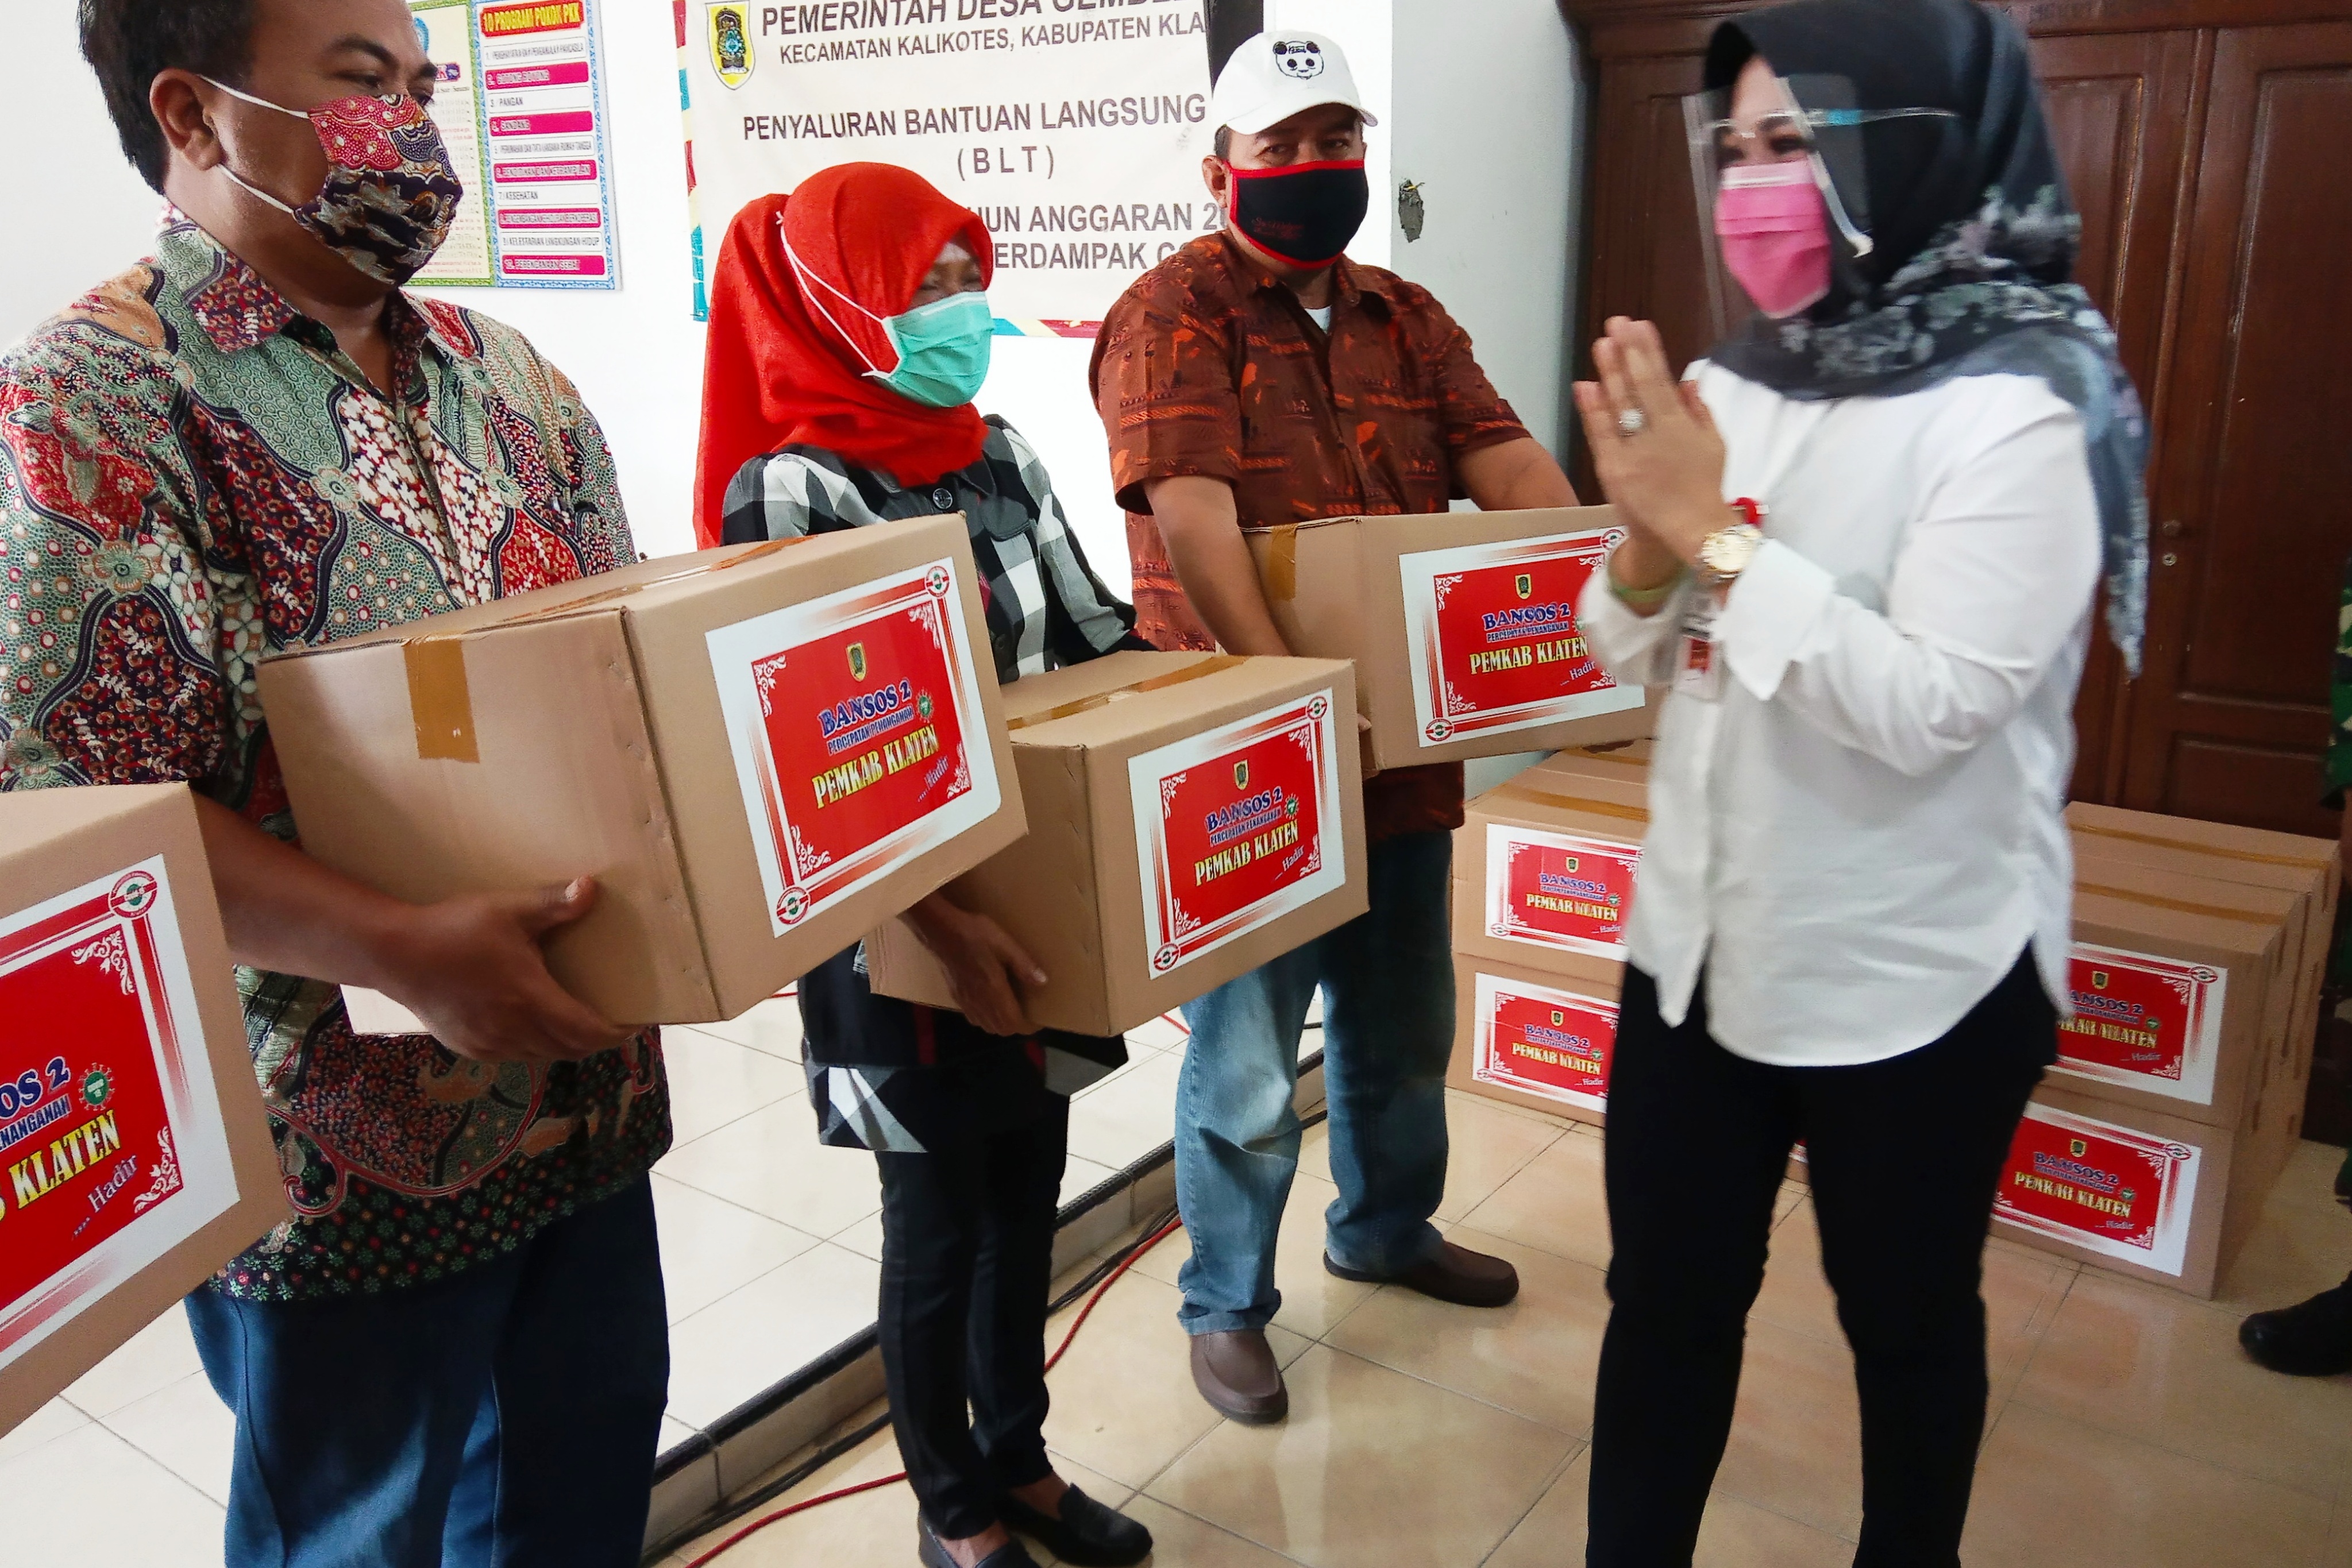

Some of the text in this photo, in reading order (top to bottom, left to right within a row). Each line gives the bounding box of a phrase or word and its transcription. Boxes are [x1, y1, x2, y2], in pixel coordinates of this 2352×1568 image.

[762, 0, 947, 36] PEMERINTAH
[958, 0, 1043, 21] DESA
[780, 36, 892, 64] KECAMATAN
[897, 28, 1015, 56] KALIKOTES,
[1021, 16, 1150, 47] KABUPATEN
[743, 94, 1206, 140] PENYALURAN BANTUAN LANGSUNG
[1028, 202, 1192, 232] ANGGARAN
[994, 242, 1148, 269] ERDAMPAK
[1560, 604, 1570, 618] 2
[1470, 636, 1588, 674] PEMKAB KLATEN
[818, 678, 912, 737] BANSOS 2
[811, 724, 940, 809] PEMKAB KLATEN
[1205, 786, 1282, 832] BANSOS 2
[1194, 819, 1298, 886] PEMKAB KLATEN
[1540, 874, 1606, 893] BANSOS 2
[1526, 894, 1618, 921] PEMKAB KLATEN
[2070, 990, 2129, 1013] ANSOS
[1512, 1042, 1557, 1064] PEMKAB
[1524, 1025, 1579, 1045] BANSOS
[1580, 1038, 1590, 1047] 2
[45, 1056, 71, 1091] 2
[8, 1109, 121, 1210] KLATEN
[87, 1155, 137, 1213] Hadir
